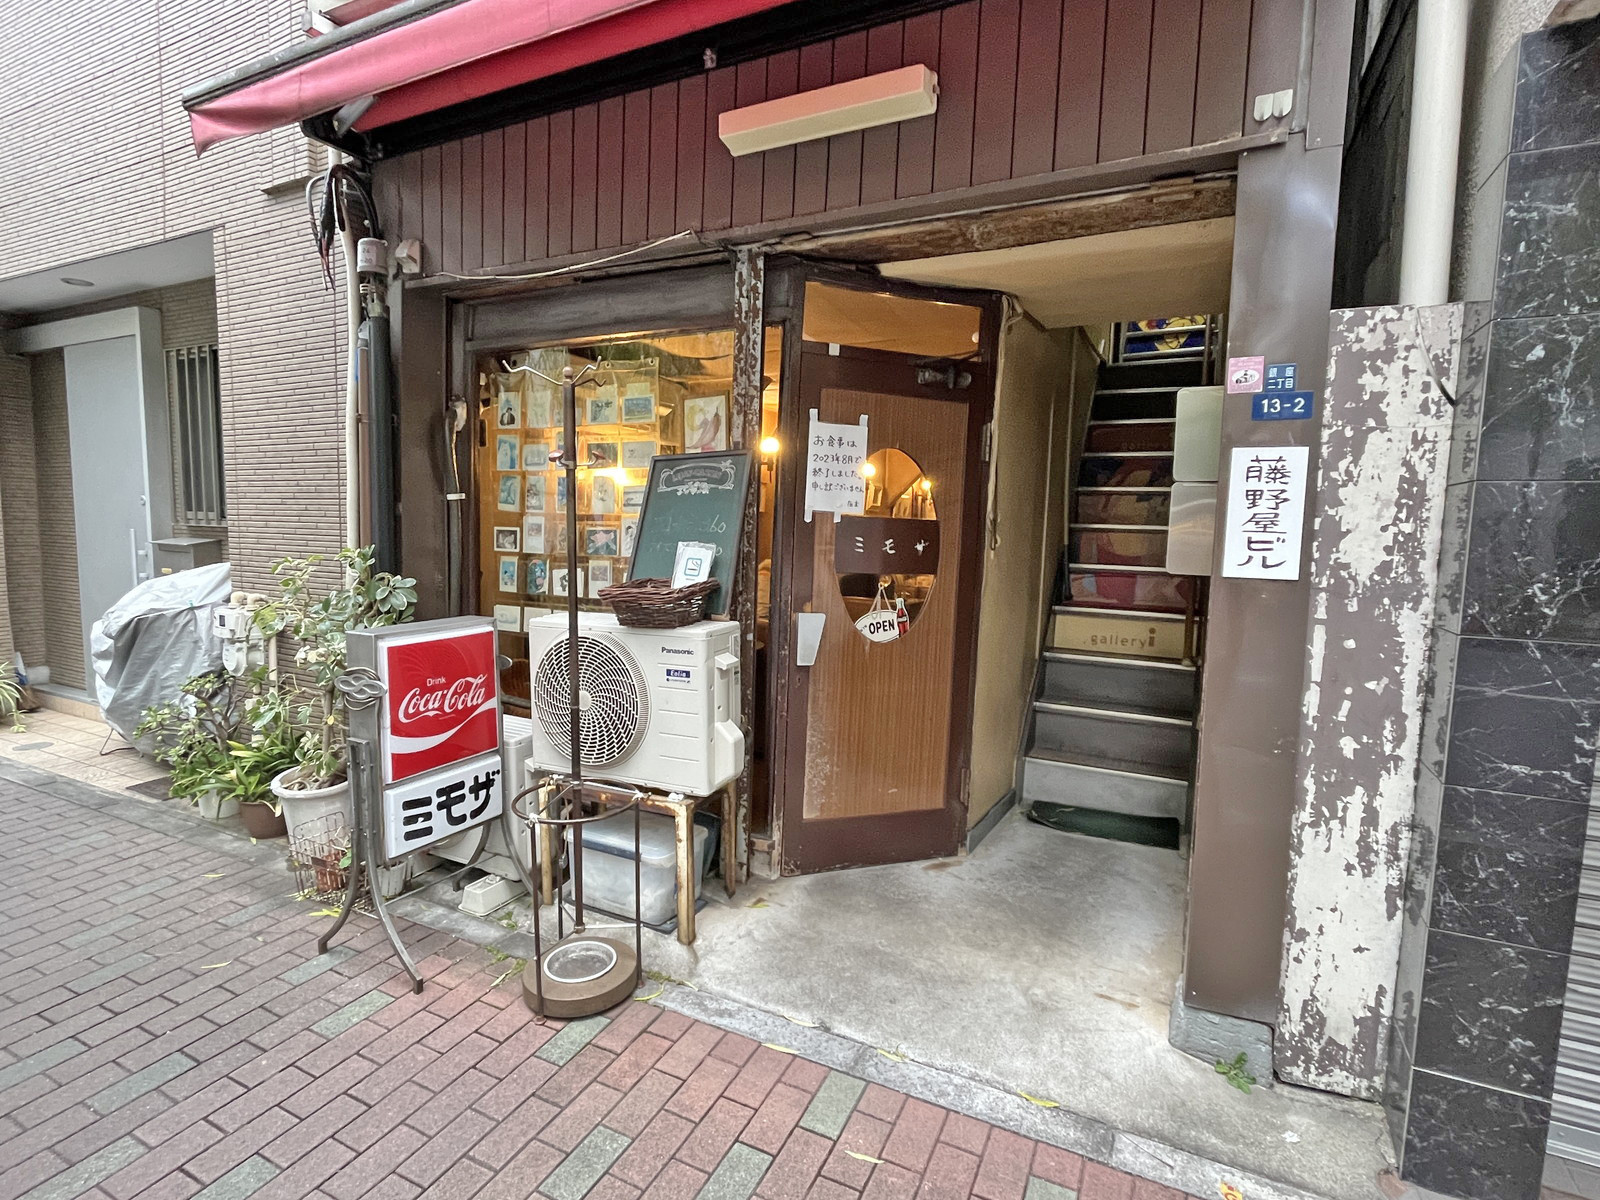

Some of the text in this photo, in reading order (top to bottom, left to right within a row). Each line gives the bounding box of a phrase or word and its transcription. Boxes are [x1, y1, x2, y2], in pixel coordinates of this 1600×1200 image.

[1267, 378, 1294, 389] 二丁目
[1261, 397, 1306, 413] 13-2
[813, 435, 858, 448] お食事は
[813, 453, 862, 465] 2023年8月で
[1237, 454, 1292, 569] 藤野屋ビル
[868, 618, 896, 635] OPEN
[661, 646, 695, 656] Panasonic
[426, 675, 447, 687] Drink
[398, 673, 488, 724] Coca-Cola
[401, 768, 501, 842] ミモザ
